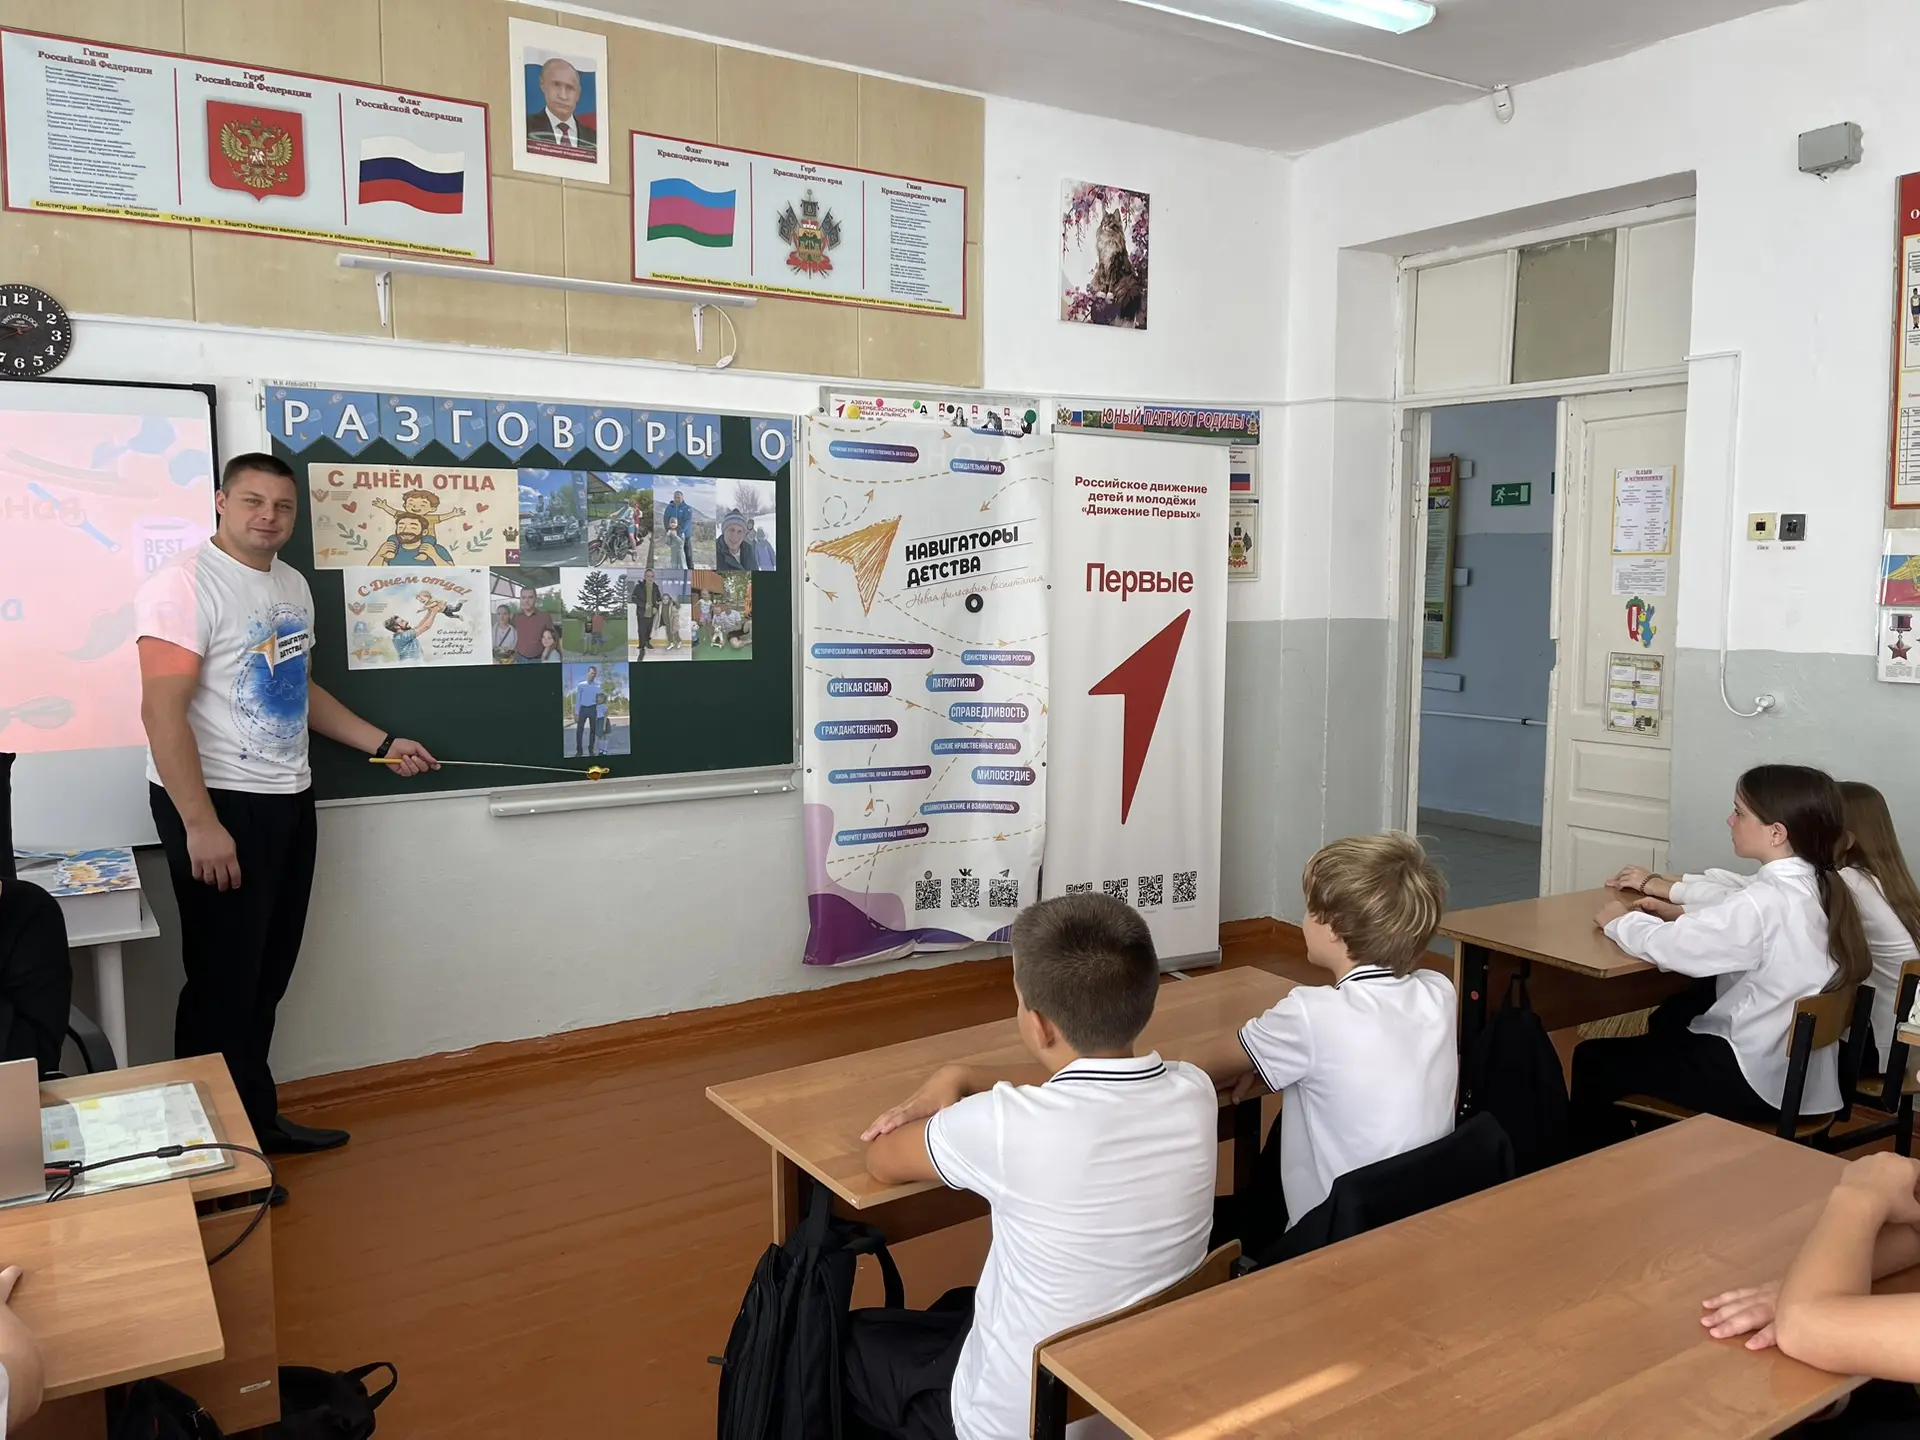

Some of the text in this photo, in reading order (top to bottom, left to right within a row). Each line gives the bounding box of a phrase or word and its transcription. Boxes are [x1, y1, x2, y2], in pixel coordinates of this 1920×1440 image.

[83, 47, 109, 58] Гимн
[38, 50, 153, 75] Российской Федерации
[243, 71, 265, 82] Герб
[195, 73, 312, 99] Российской Федерации
[398, 96, 422, 107] Флаг
[355, 98, 463, 123] Российской Федерации
[685, 145, 703, 155] Флаг
[657, 148, 730, 168] Краснодарского края
[800, 164, 816, 174] Герб
[773, 168, 843, 186] Краснодарского края
[906, 183, 922, 191] Гимн
[881, 187, 946, 204] Краснодарского края
[36, 200, 78, 211] Конституция
[82, 205, 120, 215] Российской
[124, 209, 160, 219] Федерации
[171, 214, 193, 222] Статья
[13, 293, 29, 305] 12
[37, 300, 43, 311] 1
[22, 314, 39, 328] CLOCK
[46, 313, 57, 324] 2
[51, 329, 62, 341] 3
[44, 344, 55, 356] 4
[14, 357, 25, 369] 6
[33, 355, 44, 366] 5
[857, 404, 914, 414] БЕРБЕЗОПАСНОСТИ
[1101, 405, 1245, 431] ЮНЫЙ ПАТРИОТ РОДИНЫ
[284, 399, 786, 461] РАЗГОВОРЫ О
[952, 461, 1002, 473] СОЗИДАТЕЛЬНЫЙ ТРУД
[328, 469, 496, 492] С ДНЁМ ОТЦА
[1075, 476, 1208, 494] Российское движение
[1088, 491, 1196, 506] детей и молодёжи
[1081, 504, 1201, 520] «Движение Первых»
[144, 538, 183, 555] BEST
[905, 525, 1019, 562] НАВИГАТОРЫ
[906, 556, 981, 588] ДЕТСТВА
[1086, 562, 1194, 603] Первые
[963, 653, 1032, 662] ЕДИНСТВО НАРОДОВ РОССИИ
[830, 682, 889, 693] КРЕПКАЯ СЕМЬЯ
[932, 677, 976, 688] ПАТРИОТИЗМ
[951, 706, 1027, 719] СПРАВЕДЛИВОСТЬ
[821, 723, 892, 736] ГРАЖДАНСТВЕННОСТЬ
[954, 742, 993, 750] НРАВСТВЕННЫЕ
[976, 769, 1031, 781] МИЛОСЕРДИЕ
